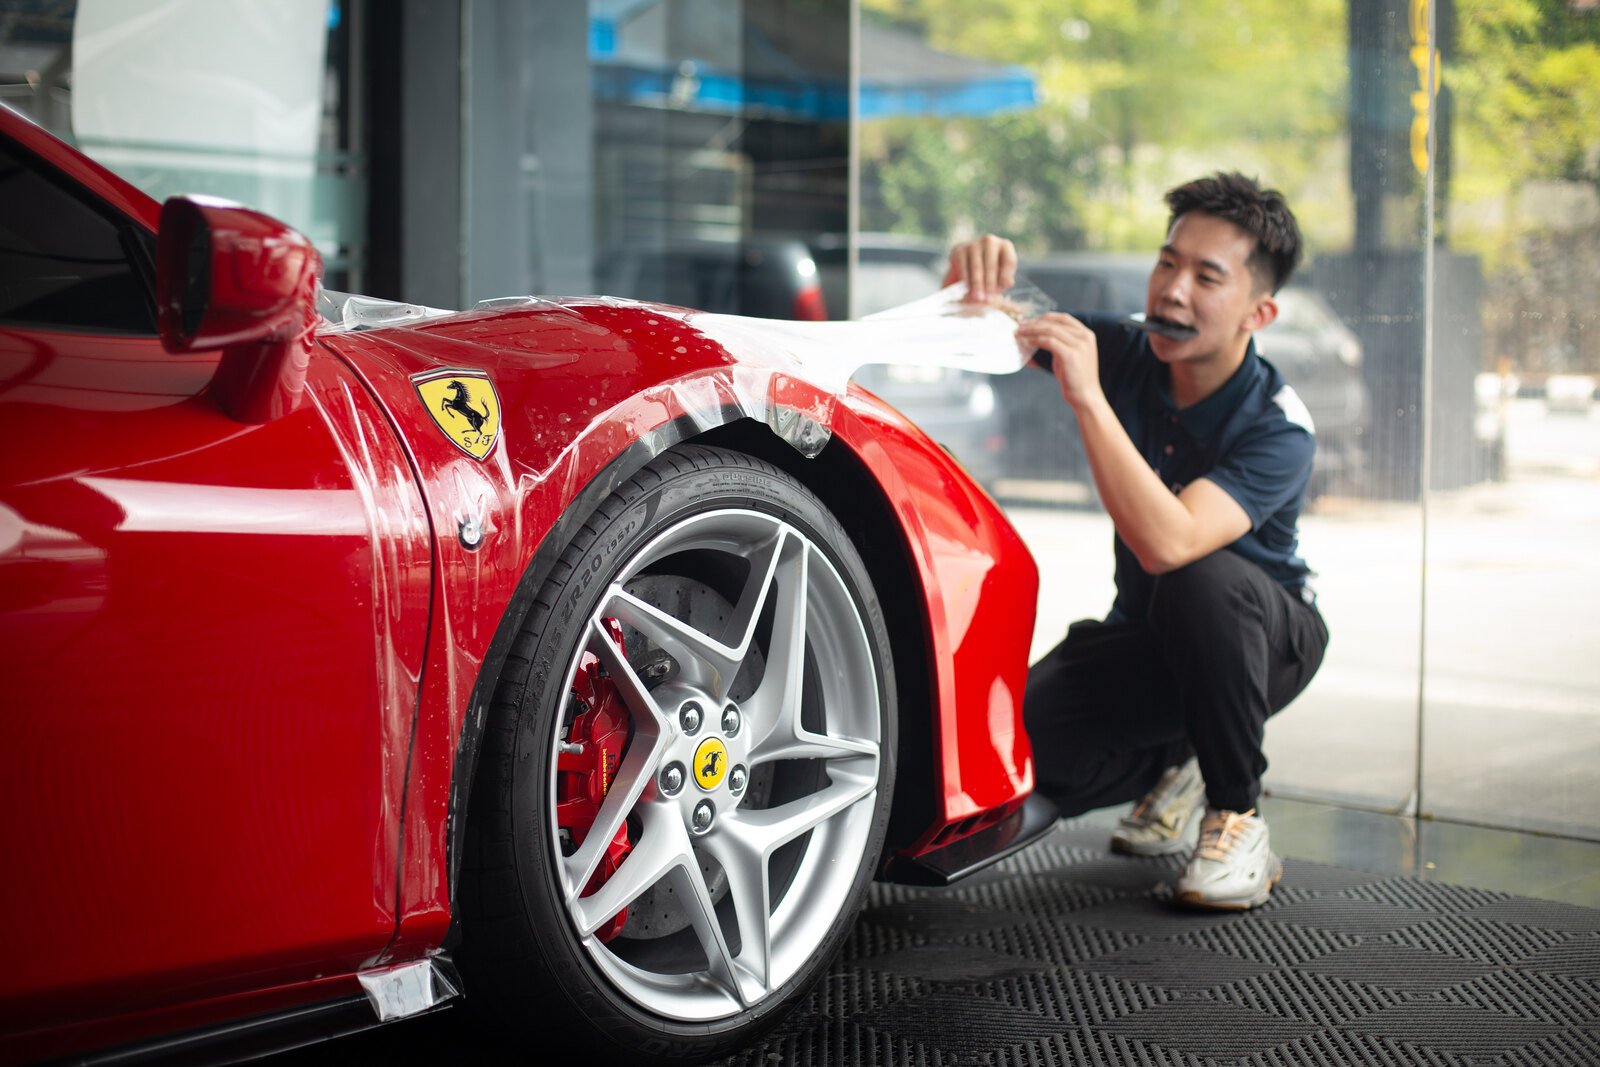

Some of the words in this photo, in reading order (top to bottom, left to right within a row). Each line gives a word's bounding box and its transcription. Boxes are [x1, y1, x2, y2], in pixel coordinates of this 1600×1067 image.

[463, 437, 473, 448] S
[481, 434, 494, 446] F
[722, 471, 773, 488] OUTSIDE
[560, 553, 602, 624] ZR20
[606, 520, 636, 555] (95Y)
